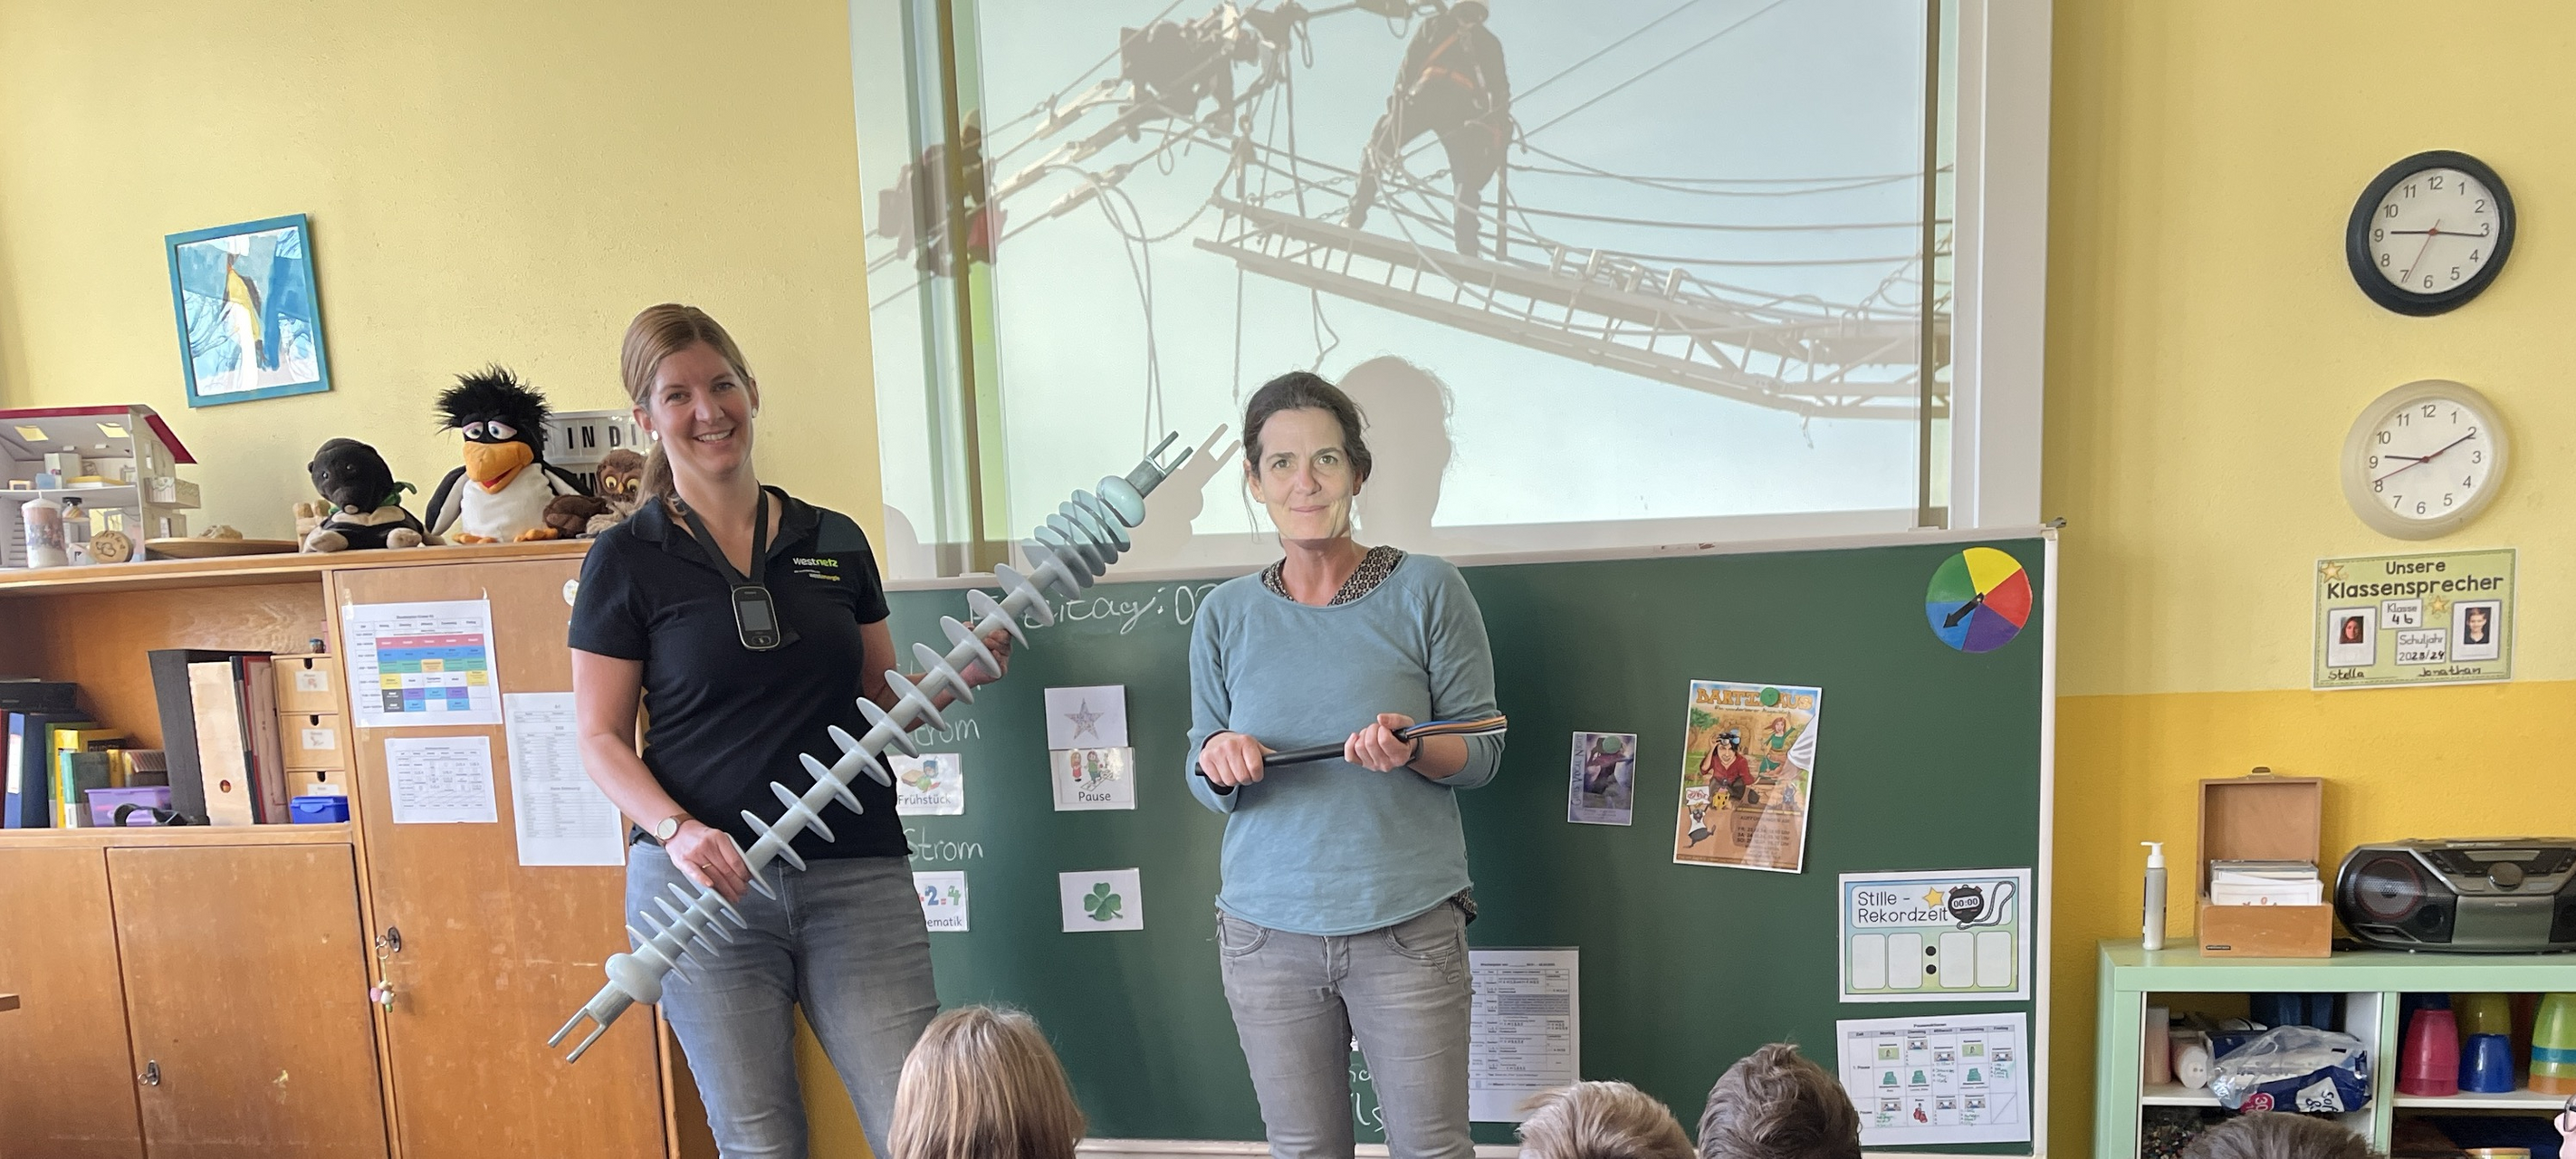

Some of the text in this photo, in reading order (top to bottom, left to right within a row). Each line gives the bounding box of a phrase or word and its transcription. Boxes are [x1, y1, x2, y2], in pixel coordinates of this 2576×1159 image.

[2428, 176, 2443, 190] 12
[2457, 182, 2465, 195] 1
[2403, 184, 2417, 198] 11
[2384, 204, 2399, 217] 10
[2475, 199, 2485, 213] 2
[2374, 228, 2384, 242] 9
[2480, 223, 2490, 236] 3
[2380, 254, 2390, 267] 8
[2469, 249, 2479, 263] 4
[2399, 270, 2408, 283] 7
[2450, 267, 2460, 281] 5
[2423, 275, 2433, 289] 6
[2421, 404, 2436, 417] 12
[2397, 414, 2409, 426] 11
[2450, 411, 2456, 424] 1
[2376, 431, 2390, 444] 10
[2467, 426, 2476, 439] 2
[2369, 455, 2379, 469] 9
[2472, 451, 2481, 464] 3
[2374, 479, 2383, 493] 8
[2463, 475, 2471, 488] 4
[2393, 495, 2402, 508] 7
[2443, 493, 2453, 506] 5
[2417, 502, 2426, 514] 6
[2386, 560, 2446, 575] Unsere
[2327, 575, 2504, 599] Klassensprecher
[2387, 603, 2418, 613] Klasse
[2392, 616, 2399, 625] 4
[2399, 635, 2443, 648] Schuljahr
[2328, 668, 2365, 679] Stella
[915, 718, 980, 746] trom
[898, 794, 951, 805] Frühstück
[1078, 791, 1111, 802] Pause
[904, 826, 983, 862] Strom
[1858, 891, 1897, 906] Stille
[1953, 897, 1978, 908] 00:00
[925, 916, 962, 927] ematik
[1858, 907, 1949, 924] Rekordzeit
